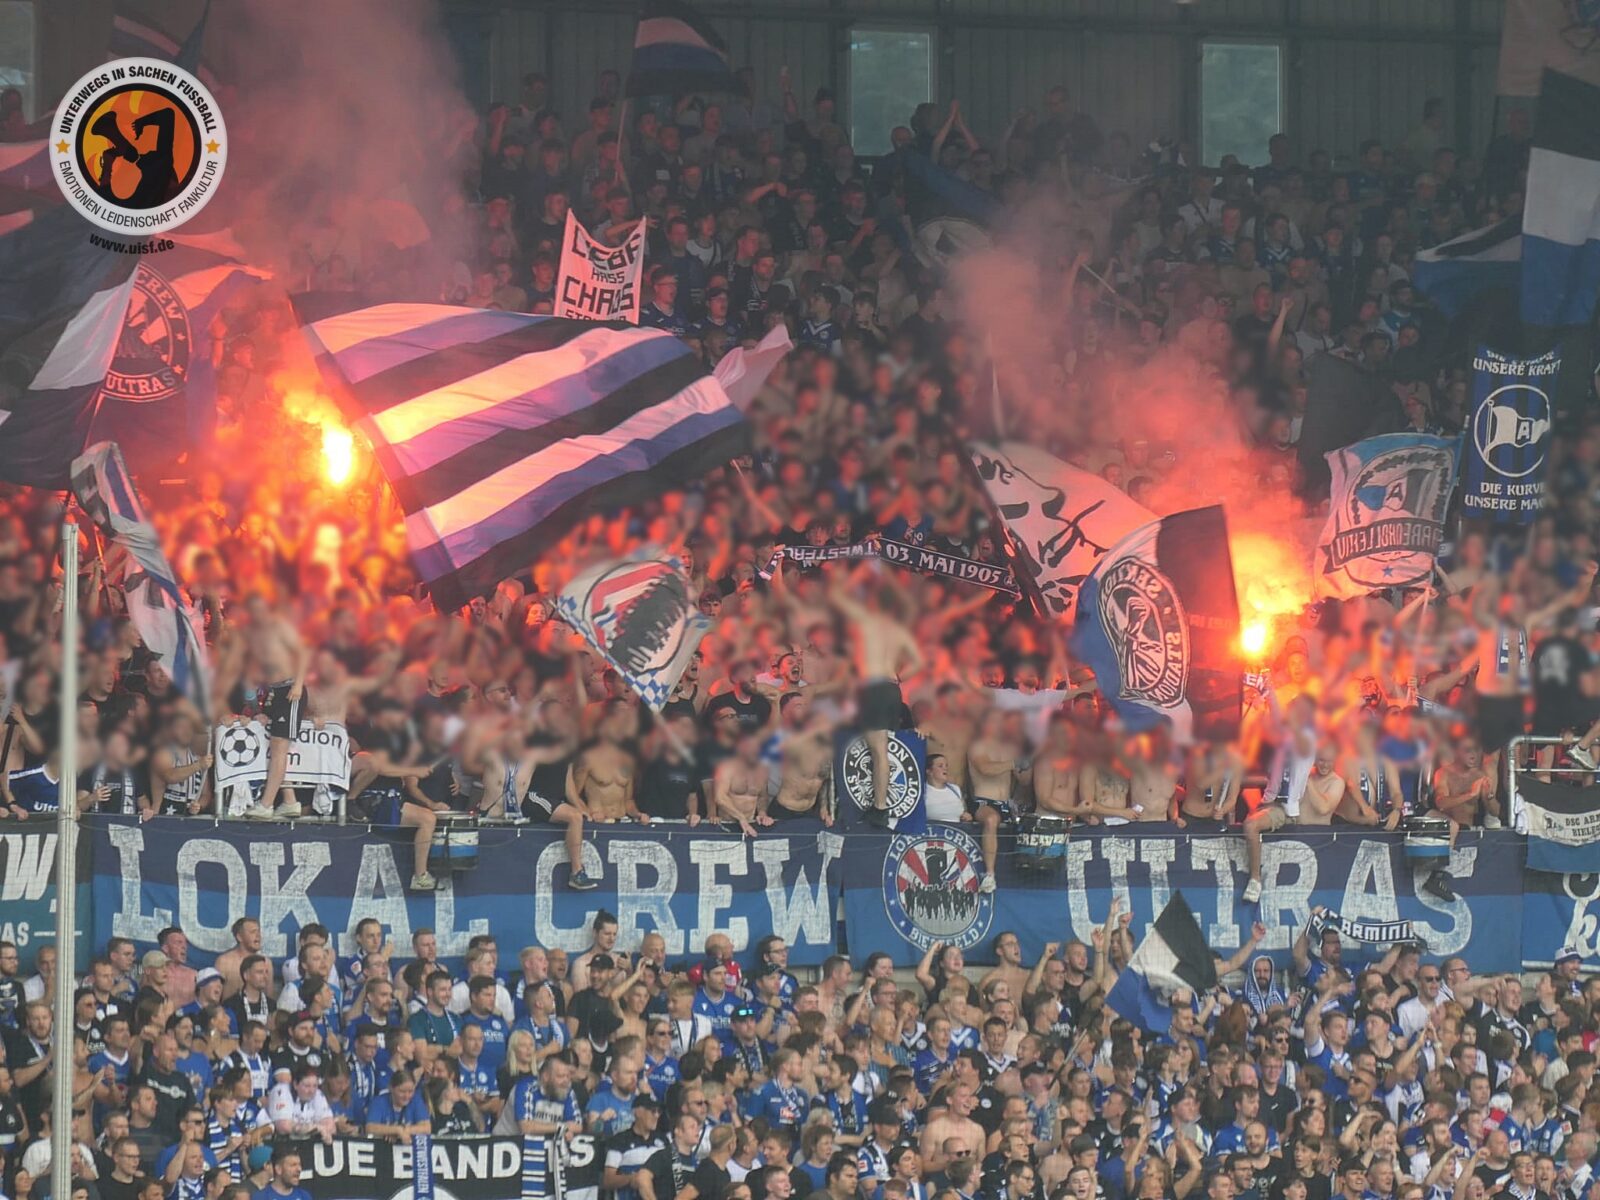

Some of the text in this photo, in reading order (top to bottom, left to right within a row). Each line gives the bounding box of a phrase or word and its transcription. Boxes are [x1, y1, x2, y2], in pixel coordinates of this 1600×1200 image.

[591, 267, 625, 284] HASS
[136, 269, 184, 320] CREW
[105, 370, 176, 394] ULTRAS
[1473, 357, 1526, 376] UNSERE
[1464, 494, 1517, 510] UNSERE
[1480, 481, 1502, 495] DIE
[886, 543, 914, 565] 03.
[918, 551, 955, 575] MAI
[959, 560, 1001, 584] 1905
[1565, 817, 1581, 827] DSC
[889, 826, 983, 864] LOL CREW
[108, 823, 845, 958] LOKAL CREW
[1066, 837, 1478, 956] ULTRAS
[393, 1135, 597, 1181] BANDS
